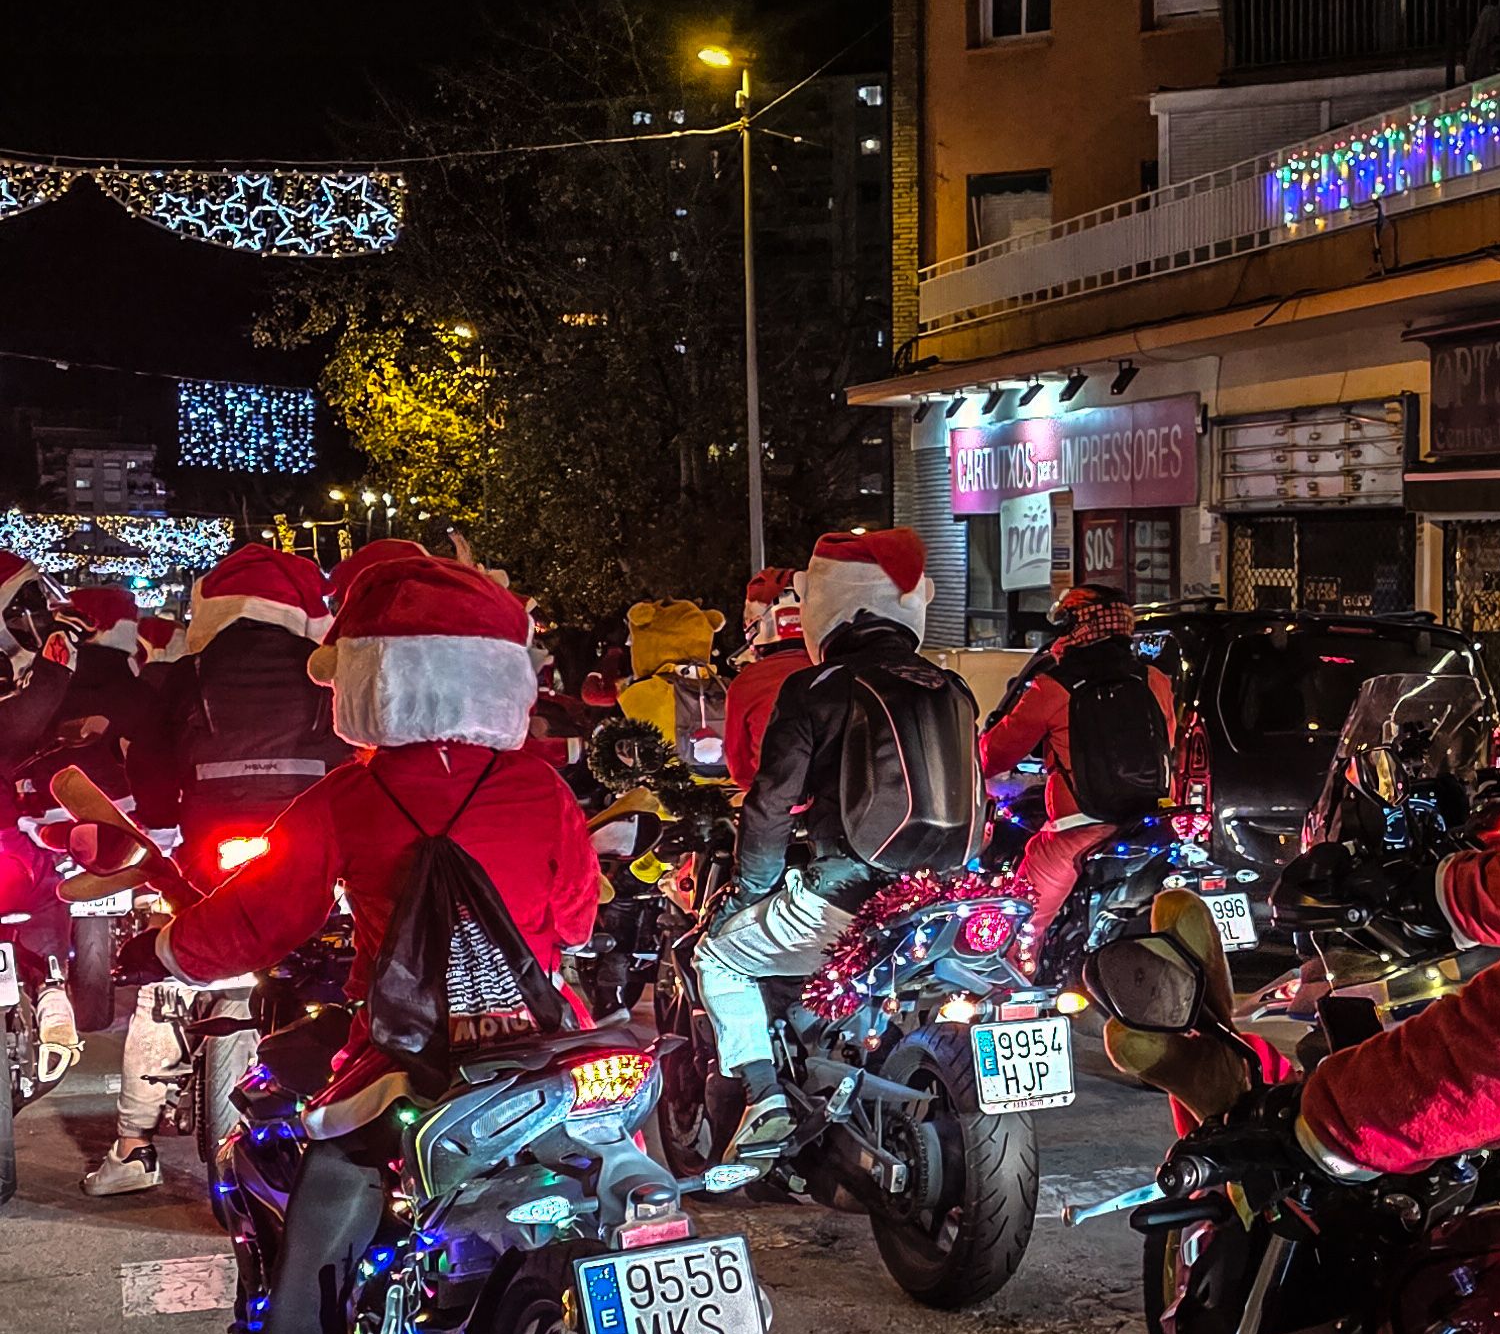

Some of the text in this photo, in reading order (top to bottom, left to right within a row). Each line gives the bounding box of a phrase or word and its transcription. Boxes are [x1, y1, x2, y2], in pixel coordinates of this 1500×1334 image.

[957, 441, 1034, 494] CARTUTXOS
[1061, 423, 1182, 485] IMPRESSORES
[1085, 527, 1115, 572] SOS
[998, 1026, 1063, 1061] 9954
[1001, 1061, 1050, 1095] HJP
[625, 1246, 743, 1310] 9556
[600, 1307, 619, 1329] E
